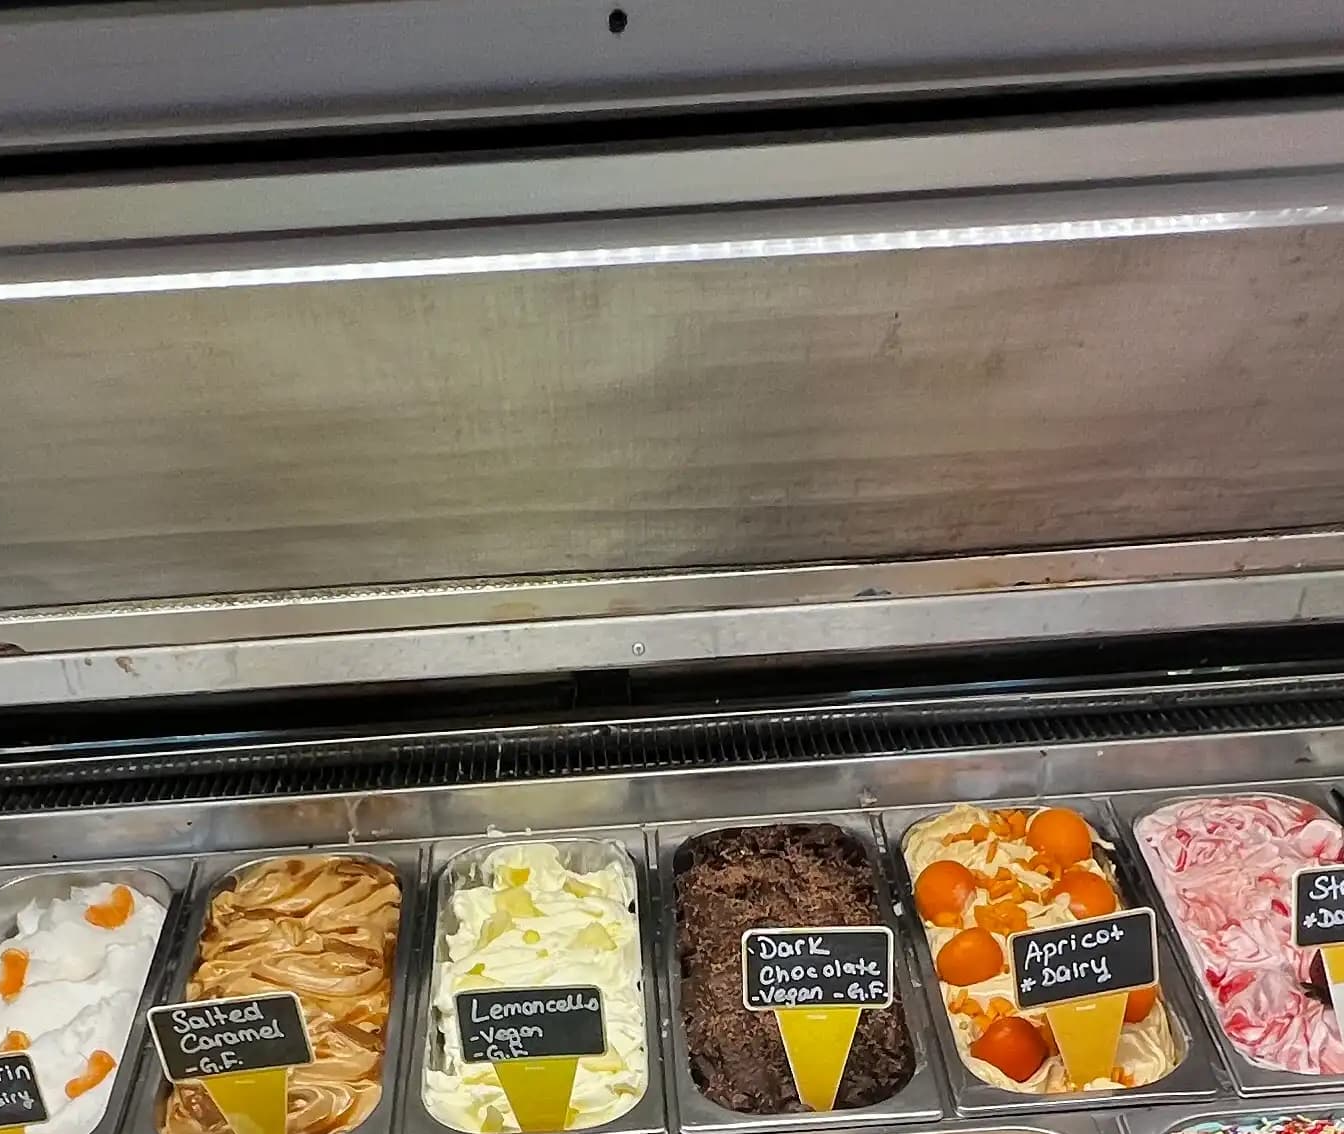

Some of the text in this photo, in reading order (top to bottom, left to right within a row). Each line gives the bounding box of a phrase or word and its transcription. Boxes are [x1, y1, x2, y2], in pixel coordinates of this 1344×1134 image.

[1024, 924, 1125, 971] Apricot
[171, 1002, 265, 1034] Salted
[471, 993, 600, 1023] Lemoncello
[180, 1019, 285, 1054] Caramel
